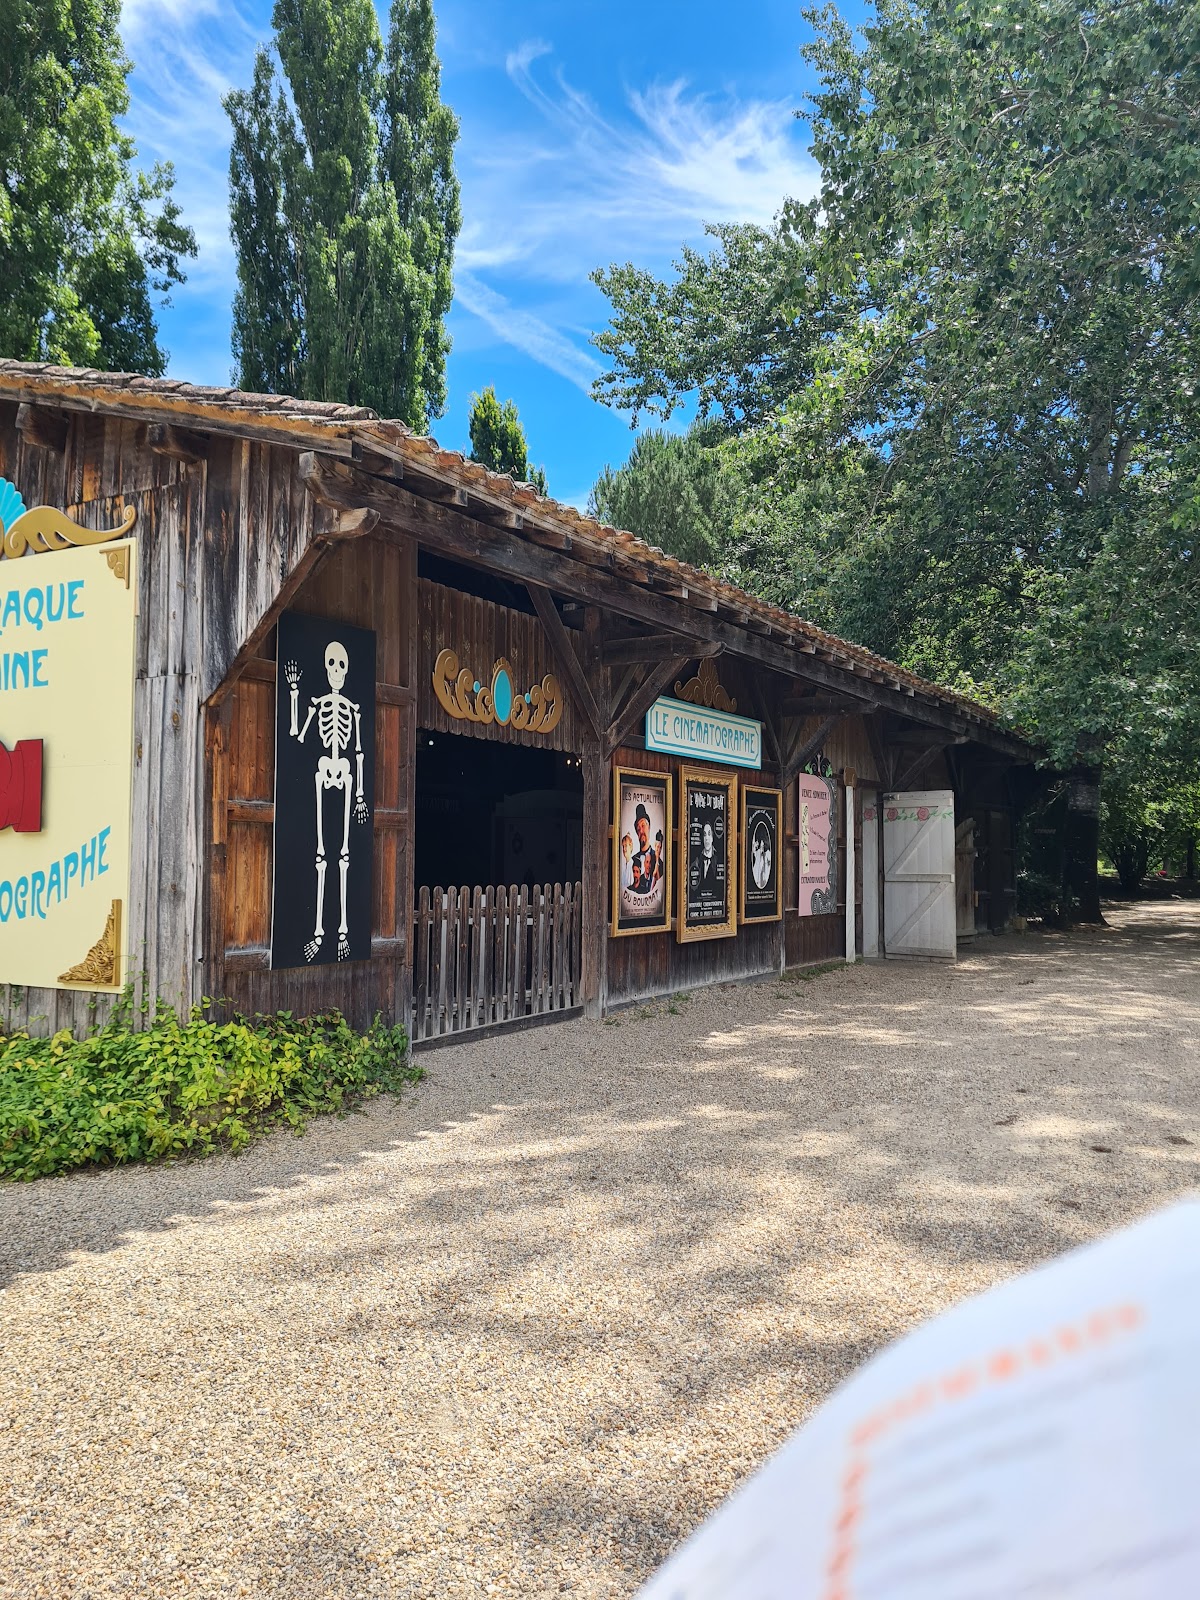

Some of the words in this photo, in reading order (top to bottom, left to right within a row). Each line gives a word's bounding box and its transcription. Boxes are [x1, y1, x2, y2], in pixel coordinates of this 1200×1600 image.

[0, 580, 84, 635] AQUE
[0, 648, 48, 690] INE
[655, 711, 669, 736] LE
[673, 716, 755, 754] CINEMATOGRAPHE
